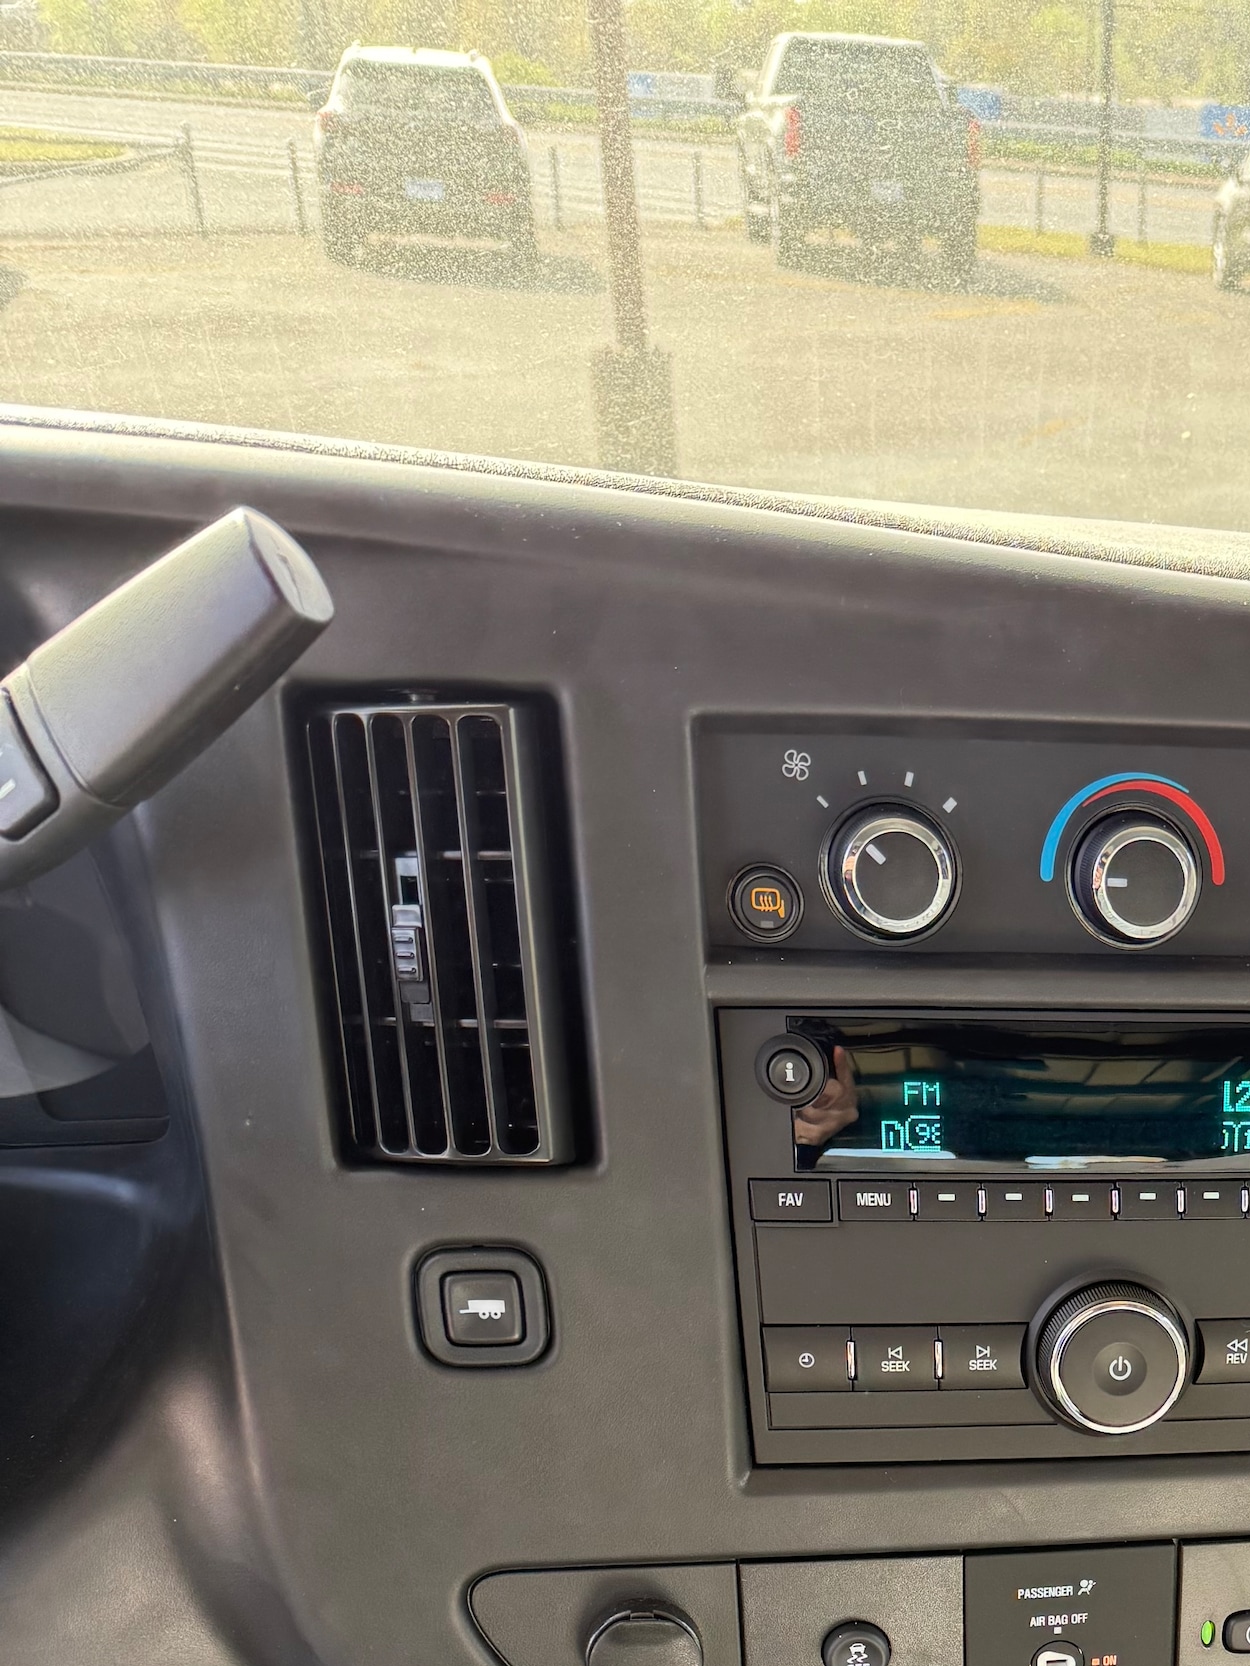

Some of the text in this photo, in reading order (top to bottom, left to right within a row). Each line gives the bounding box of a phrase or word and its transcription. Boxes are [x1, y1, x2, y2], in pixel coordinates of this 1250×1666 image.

[904, 1082, 941, 1106] FM
[778, 1193, 803, 1206] FAV
[856, 1193, 891, 1206] MENU
[969, 1359, 997, 1371] SEEK
[1226, 1353, 1247, 1364] REV
[881, 1360, 910, 1372] SEEK
[1017, 1585, 1073, 1600] PASSENGER
[1030, 1612, 1088, 1628] AIR BAG OFF
[1101, 1655, 1117, 1666] ON
